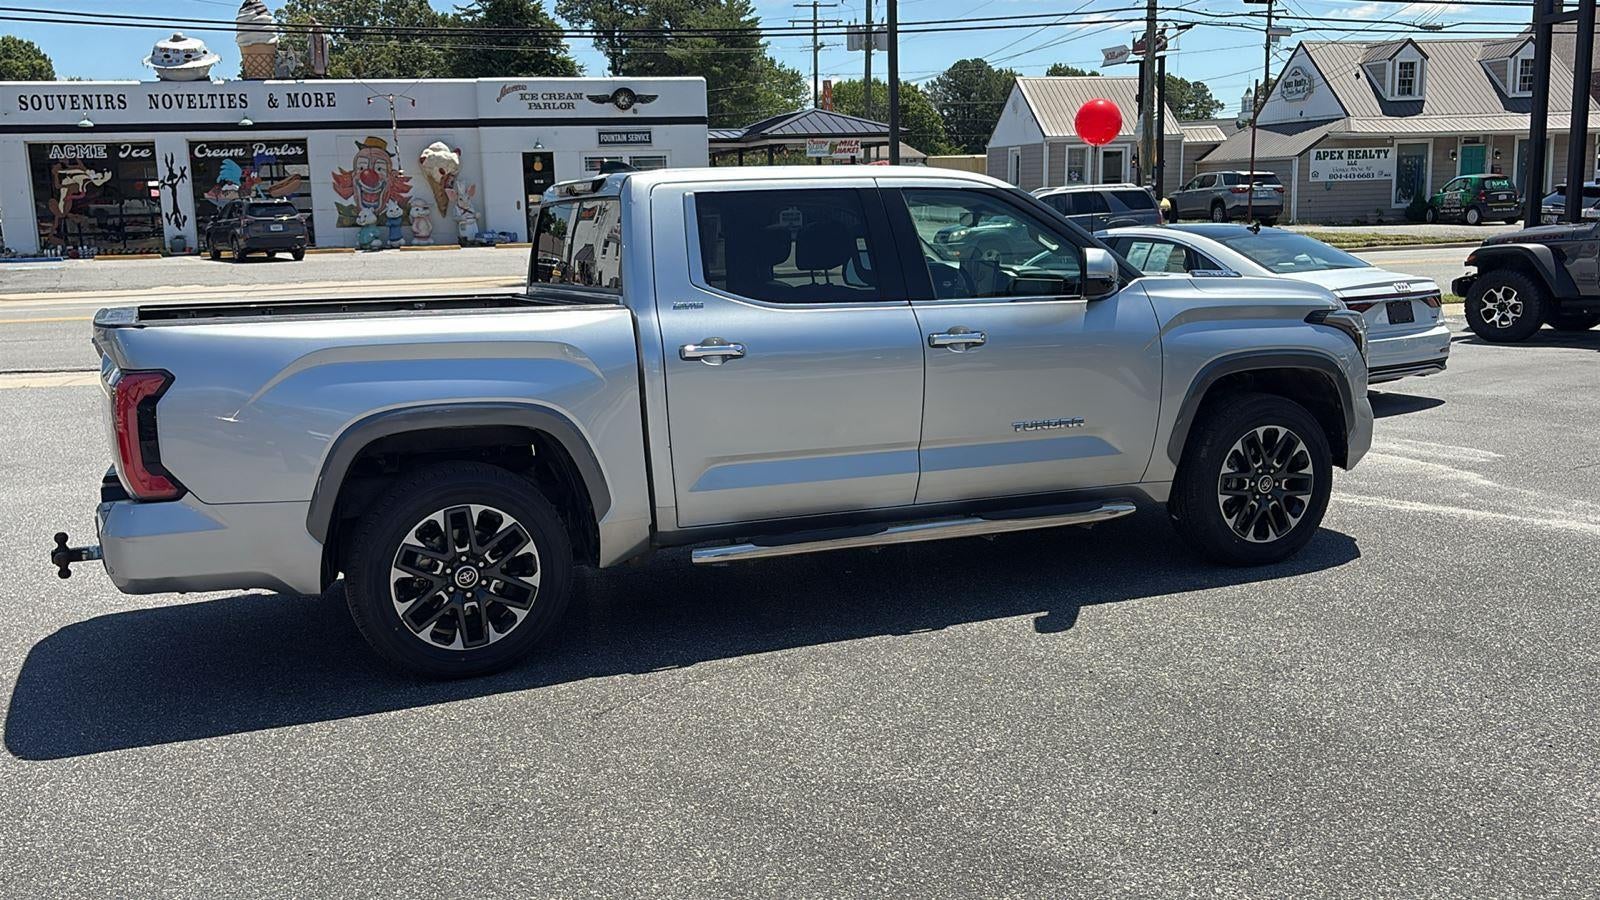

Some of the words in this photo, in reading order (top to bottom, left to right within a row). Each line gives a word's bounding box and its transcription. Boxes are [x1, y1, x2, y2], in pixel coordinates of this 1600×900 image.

[18, 94, 127, 111] SOUVENIRS
[148, 93, 249, 110] NOVELTIES
[267, 93, 279, 109] &
[286, 92, 336, 108] MORE
[519, 93, 539, 101] ICE
[541, 92, 584, 100] CREAM
[528, 102, 576, 110] PARLOR
[600, 133, 627, 142] FOUNTAIN
[628, 133, 650, 142] SERVICE
[49, 144, 108, 159] ACME
[118, 143, 152, 158] Ice
[194, 143, 246, 158] Cream
[252, 143, 304, 157] Parlor
[1315, 150, 1344, 161] APEX
[1347, 149, 1390, 160] REALTY
[1012, 416, 1084, 432] TUNDRA
